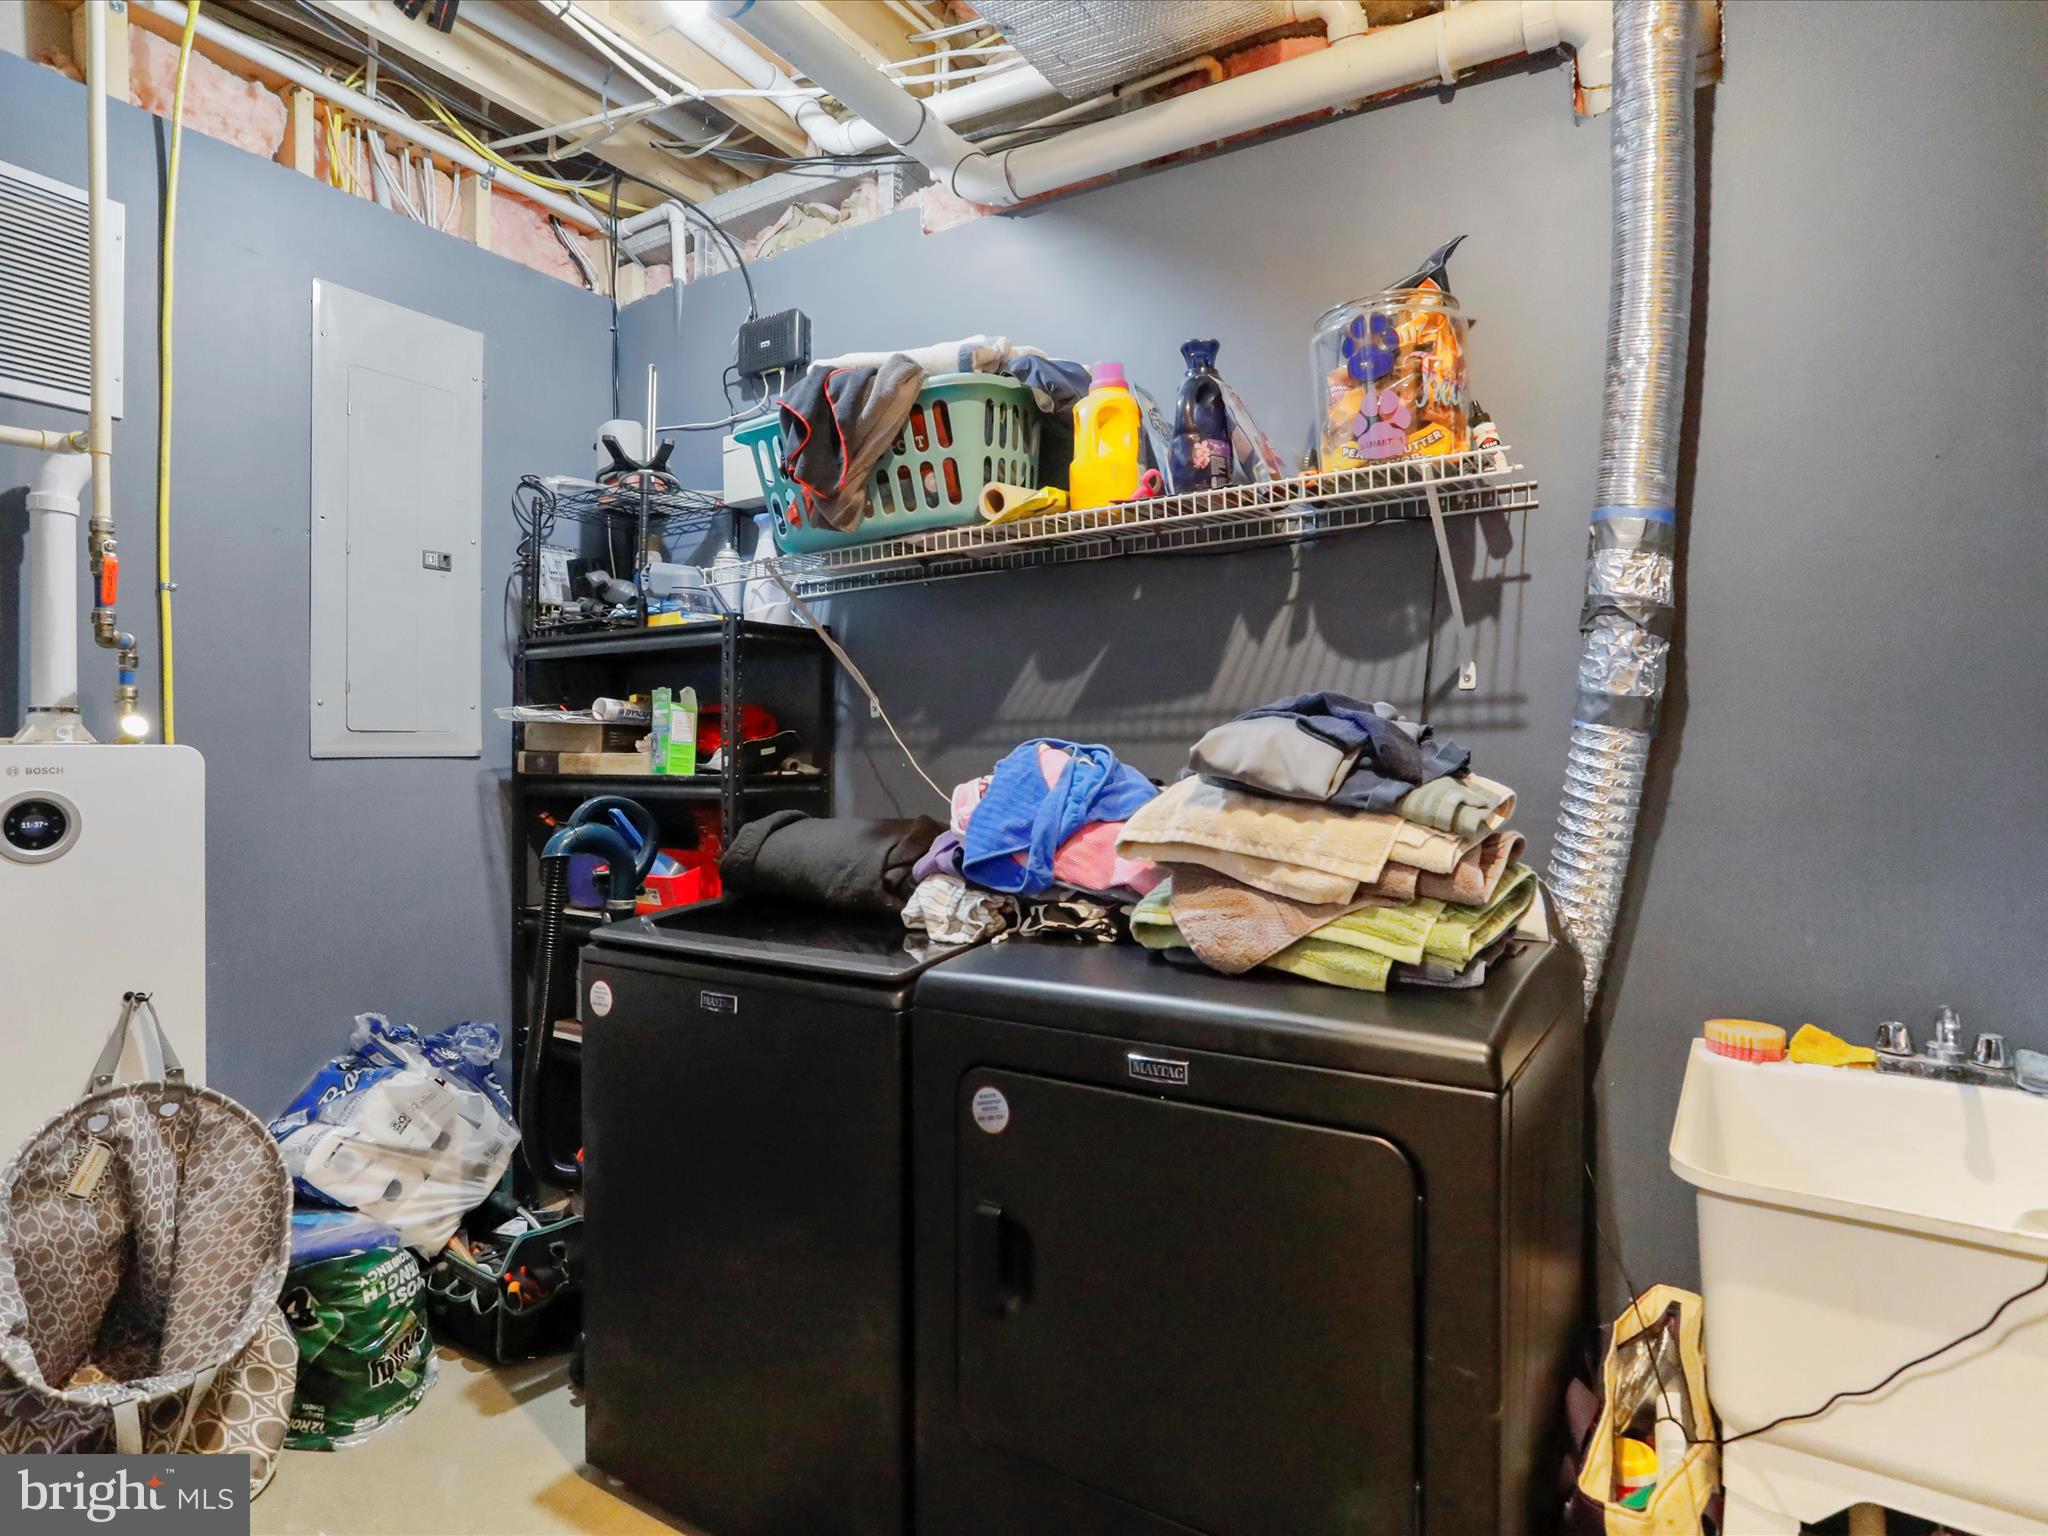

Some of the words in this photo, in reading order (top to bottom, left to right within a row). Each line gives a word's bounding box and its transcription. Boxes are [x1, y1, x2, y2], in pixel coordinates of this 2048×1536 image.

[1403, 430, 1442, 453] UTTER
[25, 766, 64, 775] BOSCH
[1132, 1062, 1184, 1079] MAYTAG
